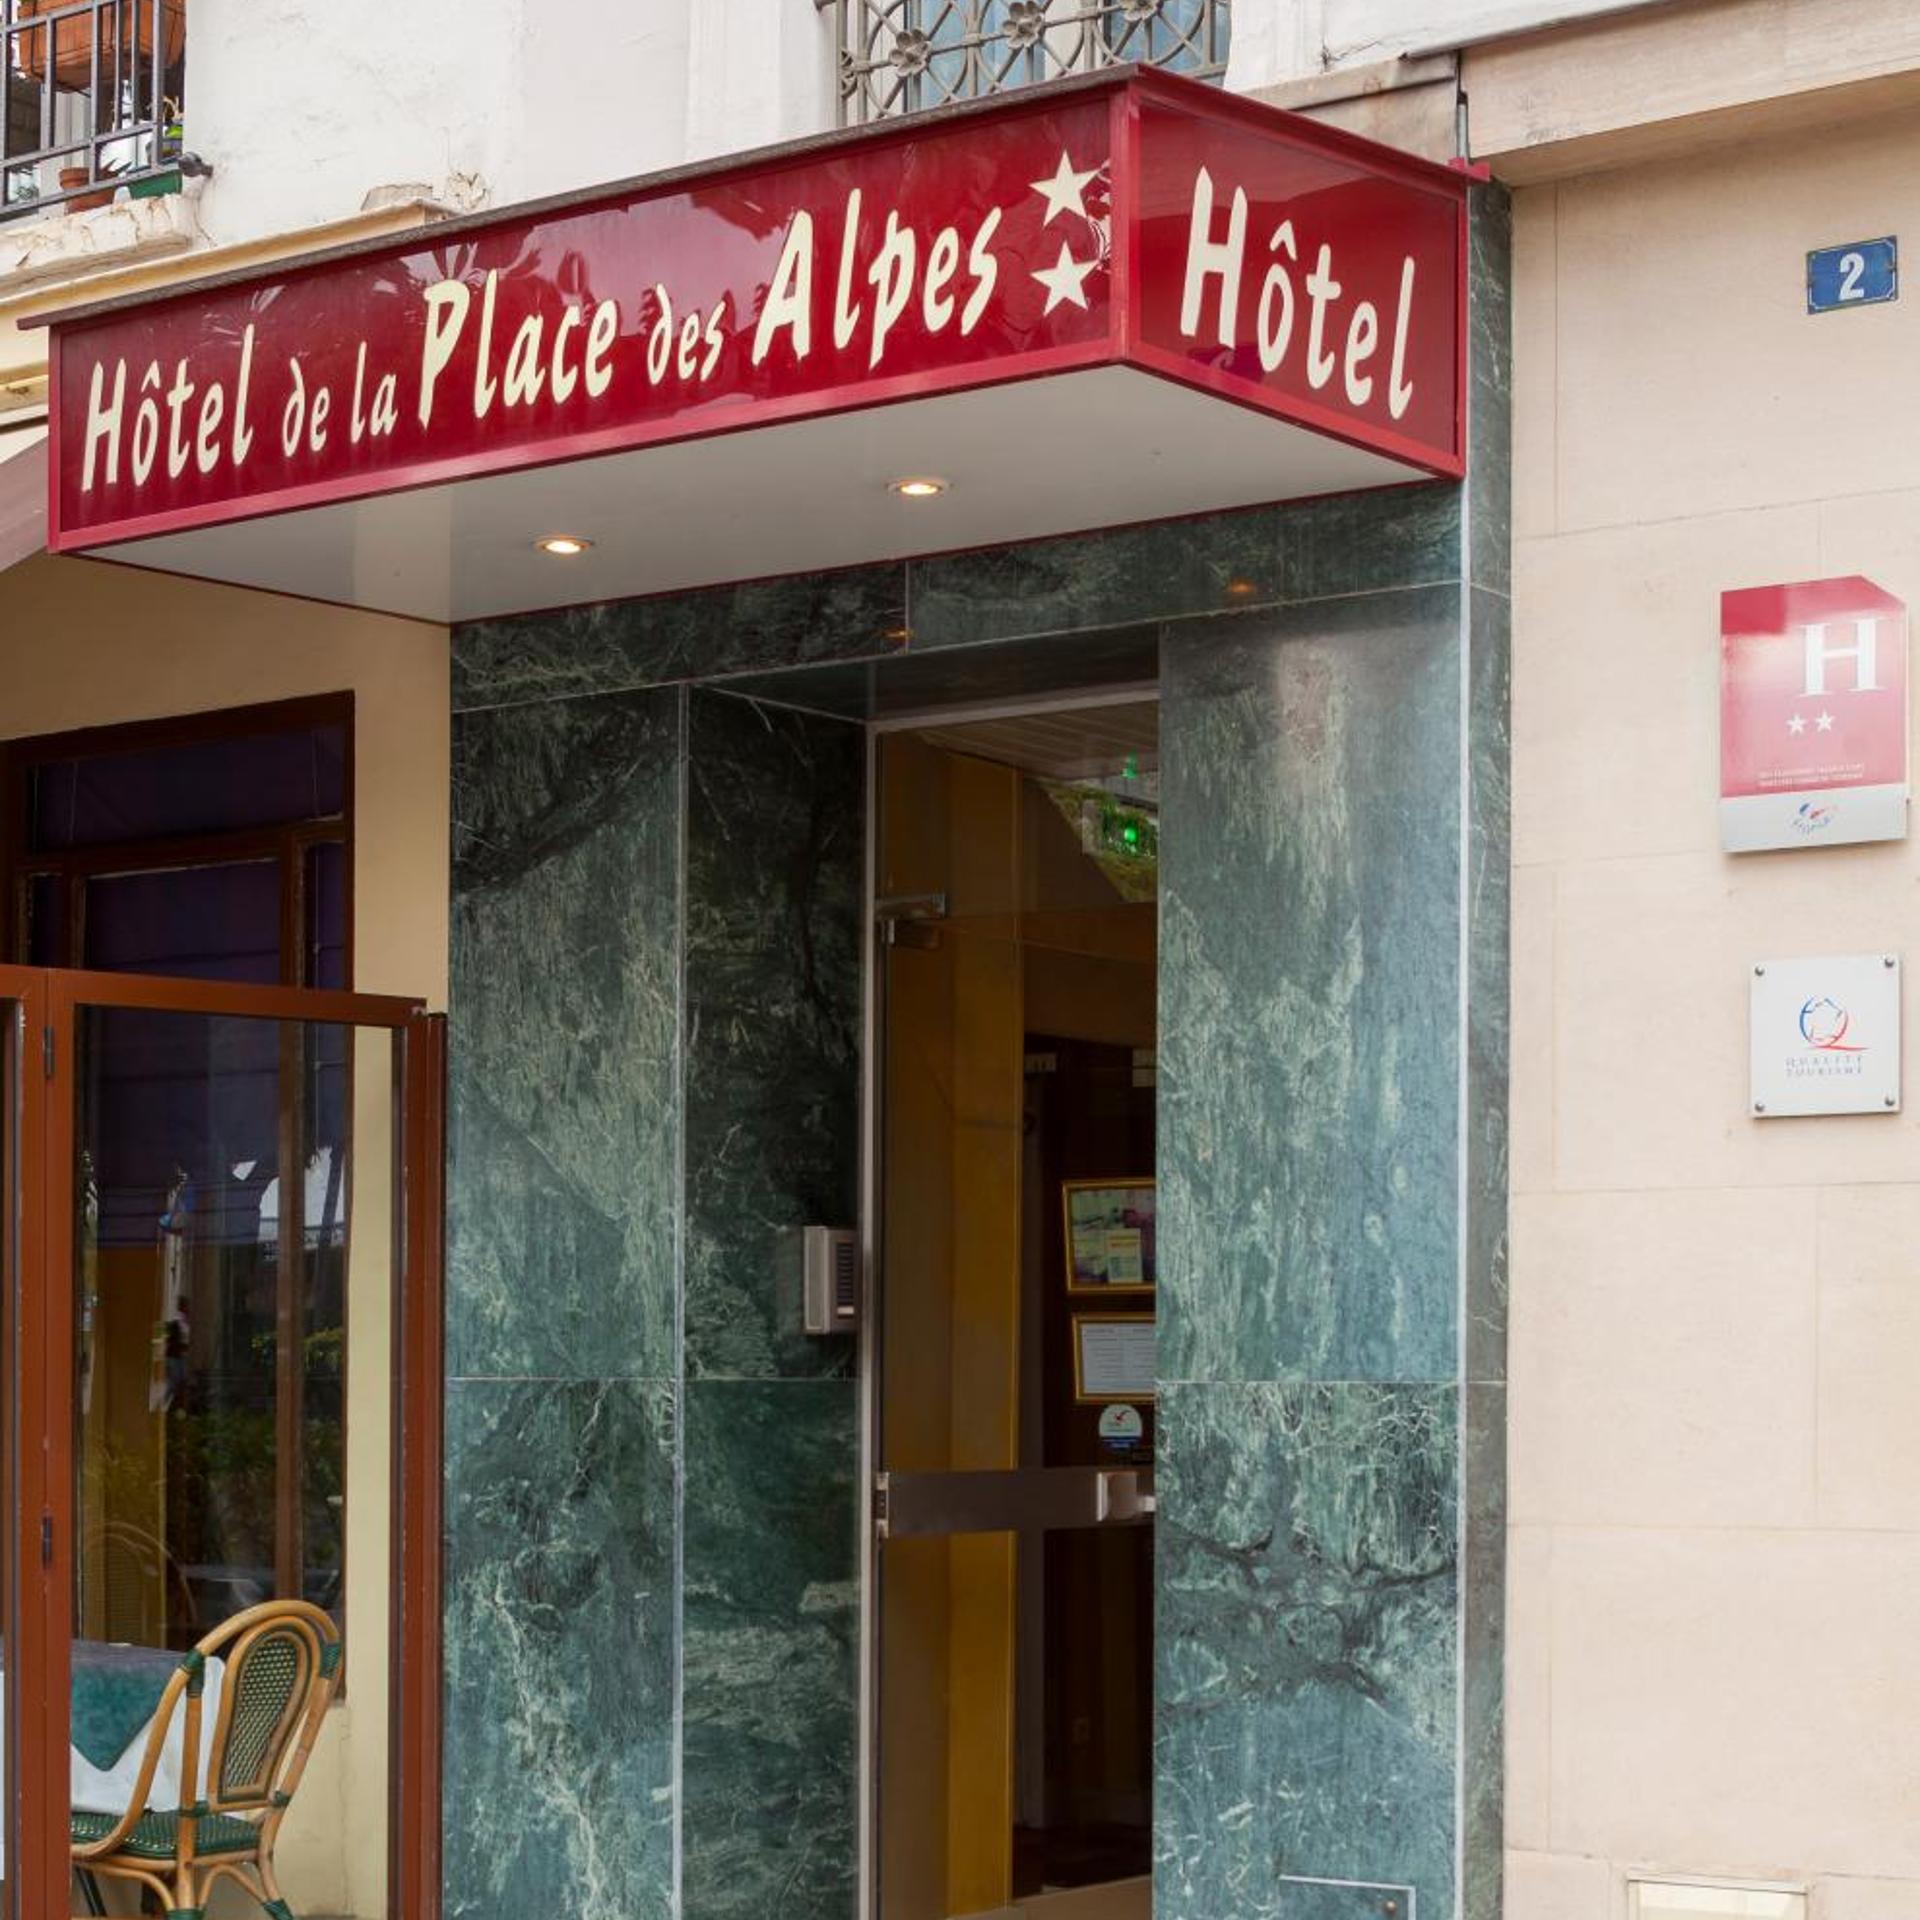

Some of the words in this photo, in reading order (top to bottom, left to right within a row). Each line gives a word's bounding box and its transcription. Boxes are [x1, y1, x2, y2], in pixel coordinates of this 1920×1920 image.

[81, 322, 255, 492] Hôtel
[282, 357, 331, 457] de
[350, 341, 398, 444] la
[418, 268, 619, 430] Place
[647, 283, 726, 385] des
[752, 188, 1002, 372] Alpes
[1180, 165, 1415, 420] Hôtel
[1838, 252, 1865, 302] 2
[1798, 616, 1890, 697] H
